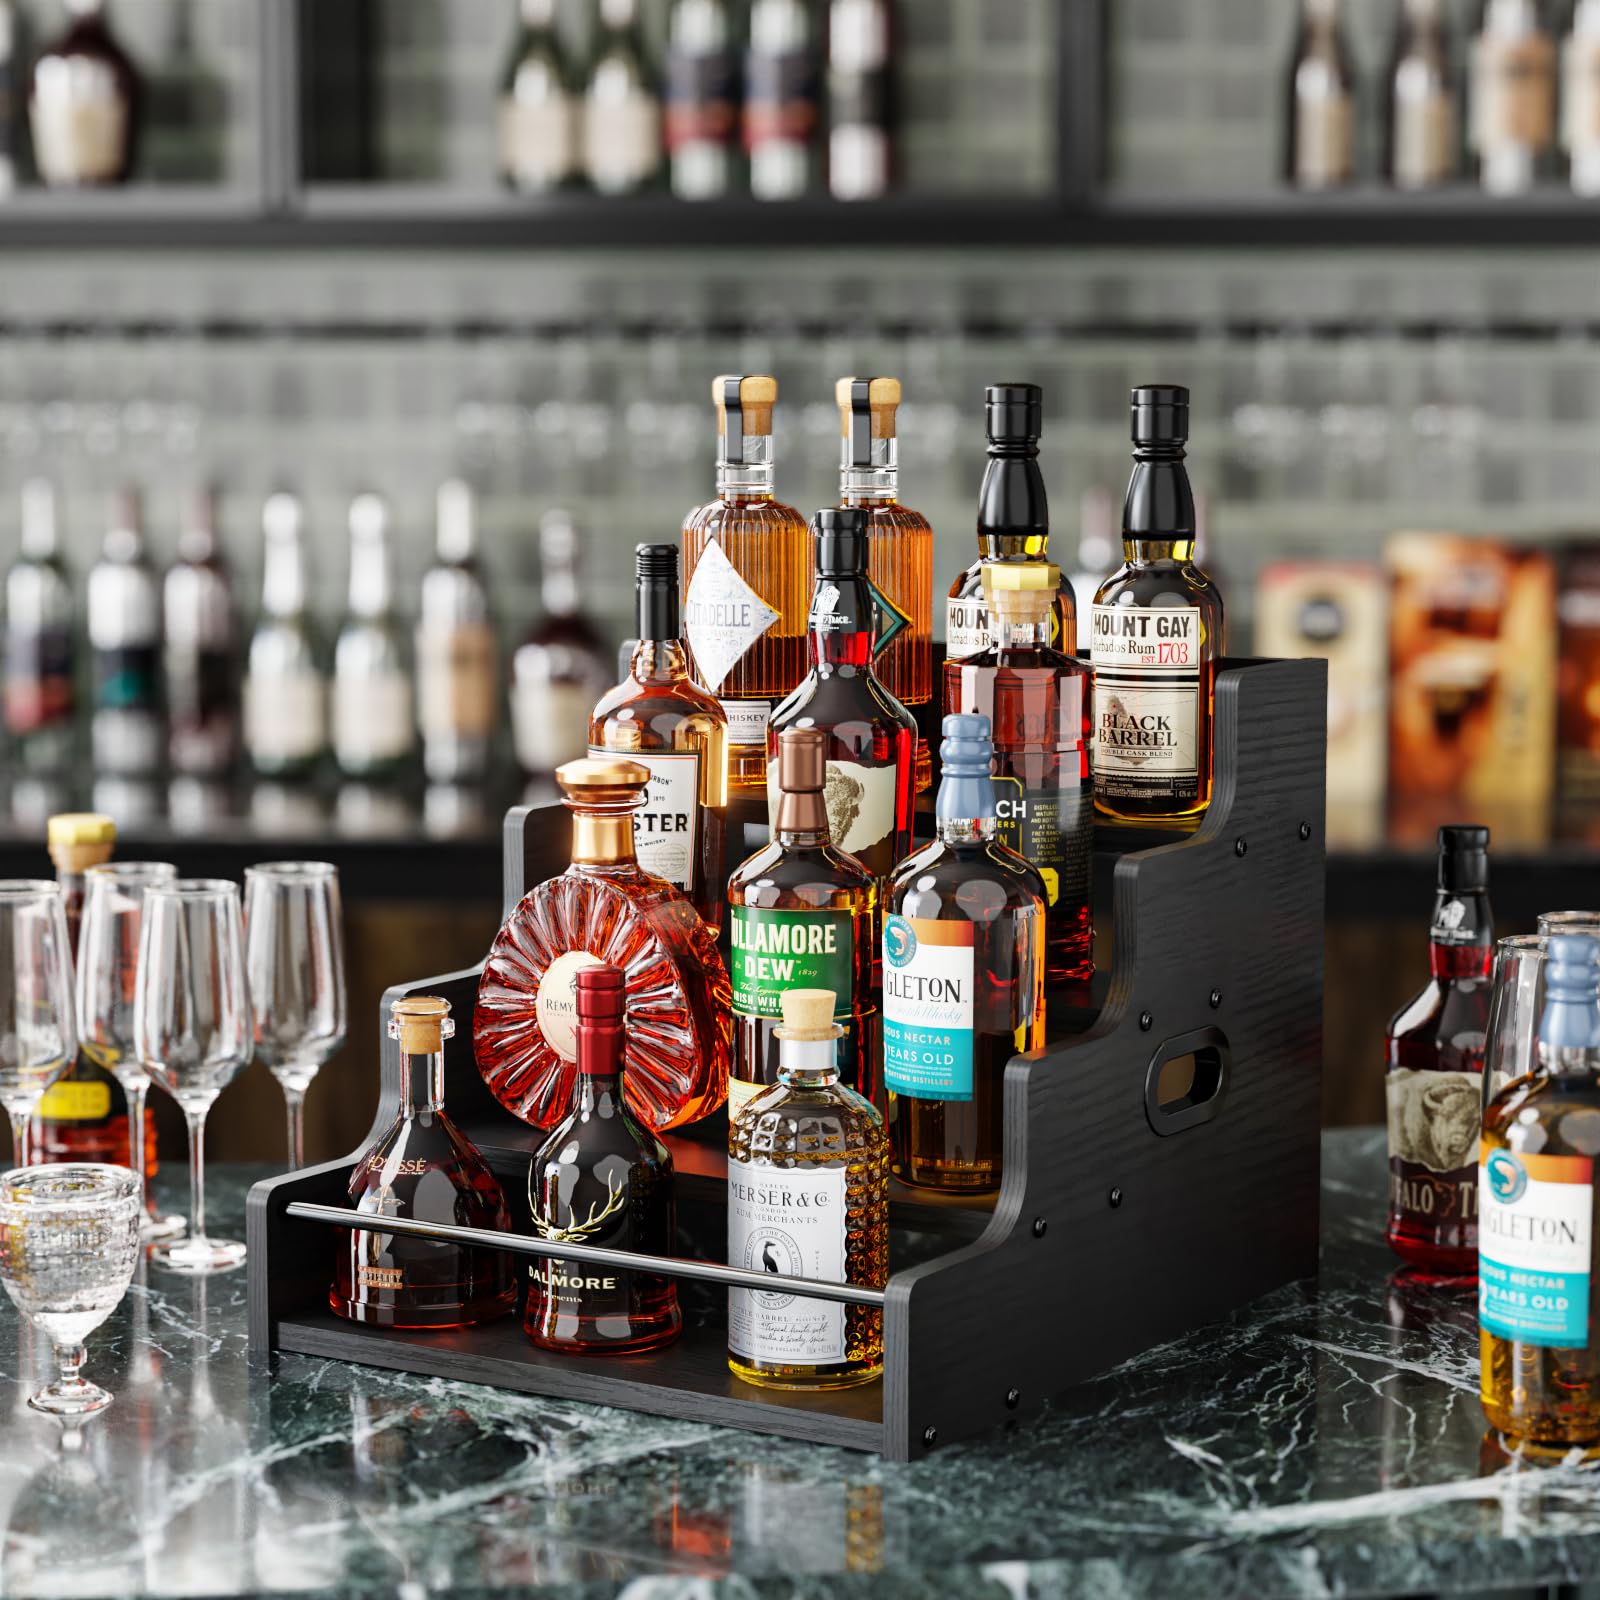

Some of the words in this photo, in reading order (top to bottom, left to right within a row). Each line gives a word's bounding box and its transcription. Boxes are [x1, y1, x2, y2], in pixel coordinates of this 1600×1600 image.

[689, 600, 751, 627] CITADELLE
[1094, 613, 1151, 638] MOUNT
[1156, 616, 1190, 638] GAY
[1128, 640, 1155, 655] Rum
[1157, 642, 1188, 664] 1703
[726, 714, 765, 722] HISKEY
[1102, 713, 1171, 731] BLACK
[1099, 728, 1178, 746] BARREL
[733, 990, 753, 1005] IRISH
[904, 1032, 951, 1045] NECTAR
[922, 1052, 954, 1066] OLD
[731, 1181, 792, 1206] MERSER
[797, 1193, 809, 1207] &
[528, 1265, 616, 1289] DALMORE
[1531, 1295, 1569, 1311] OLD
